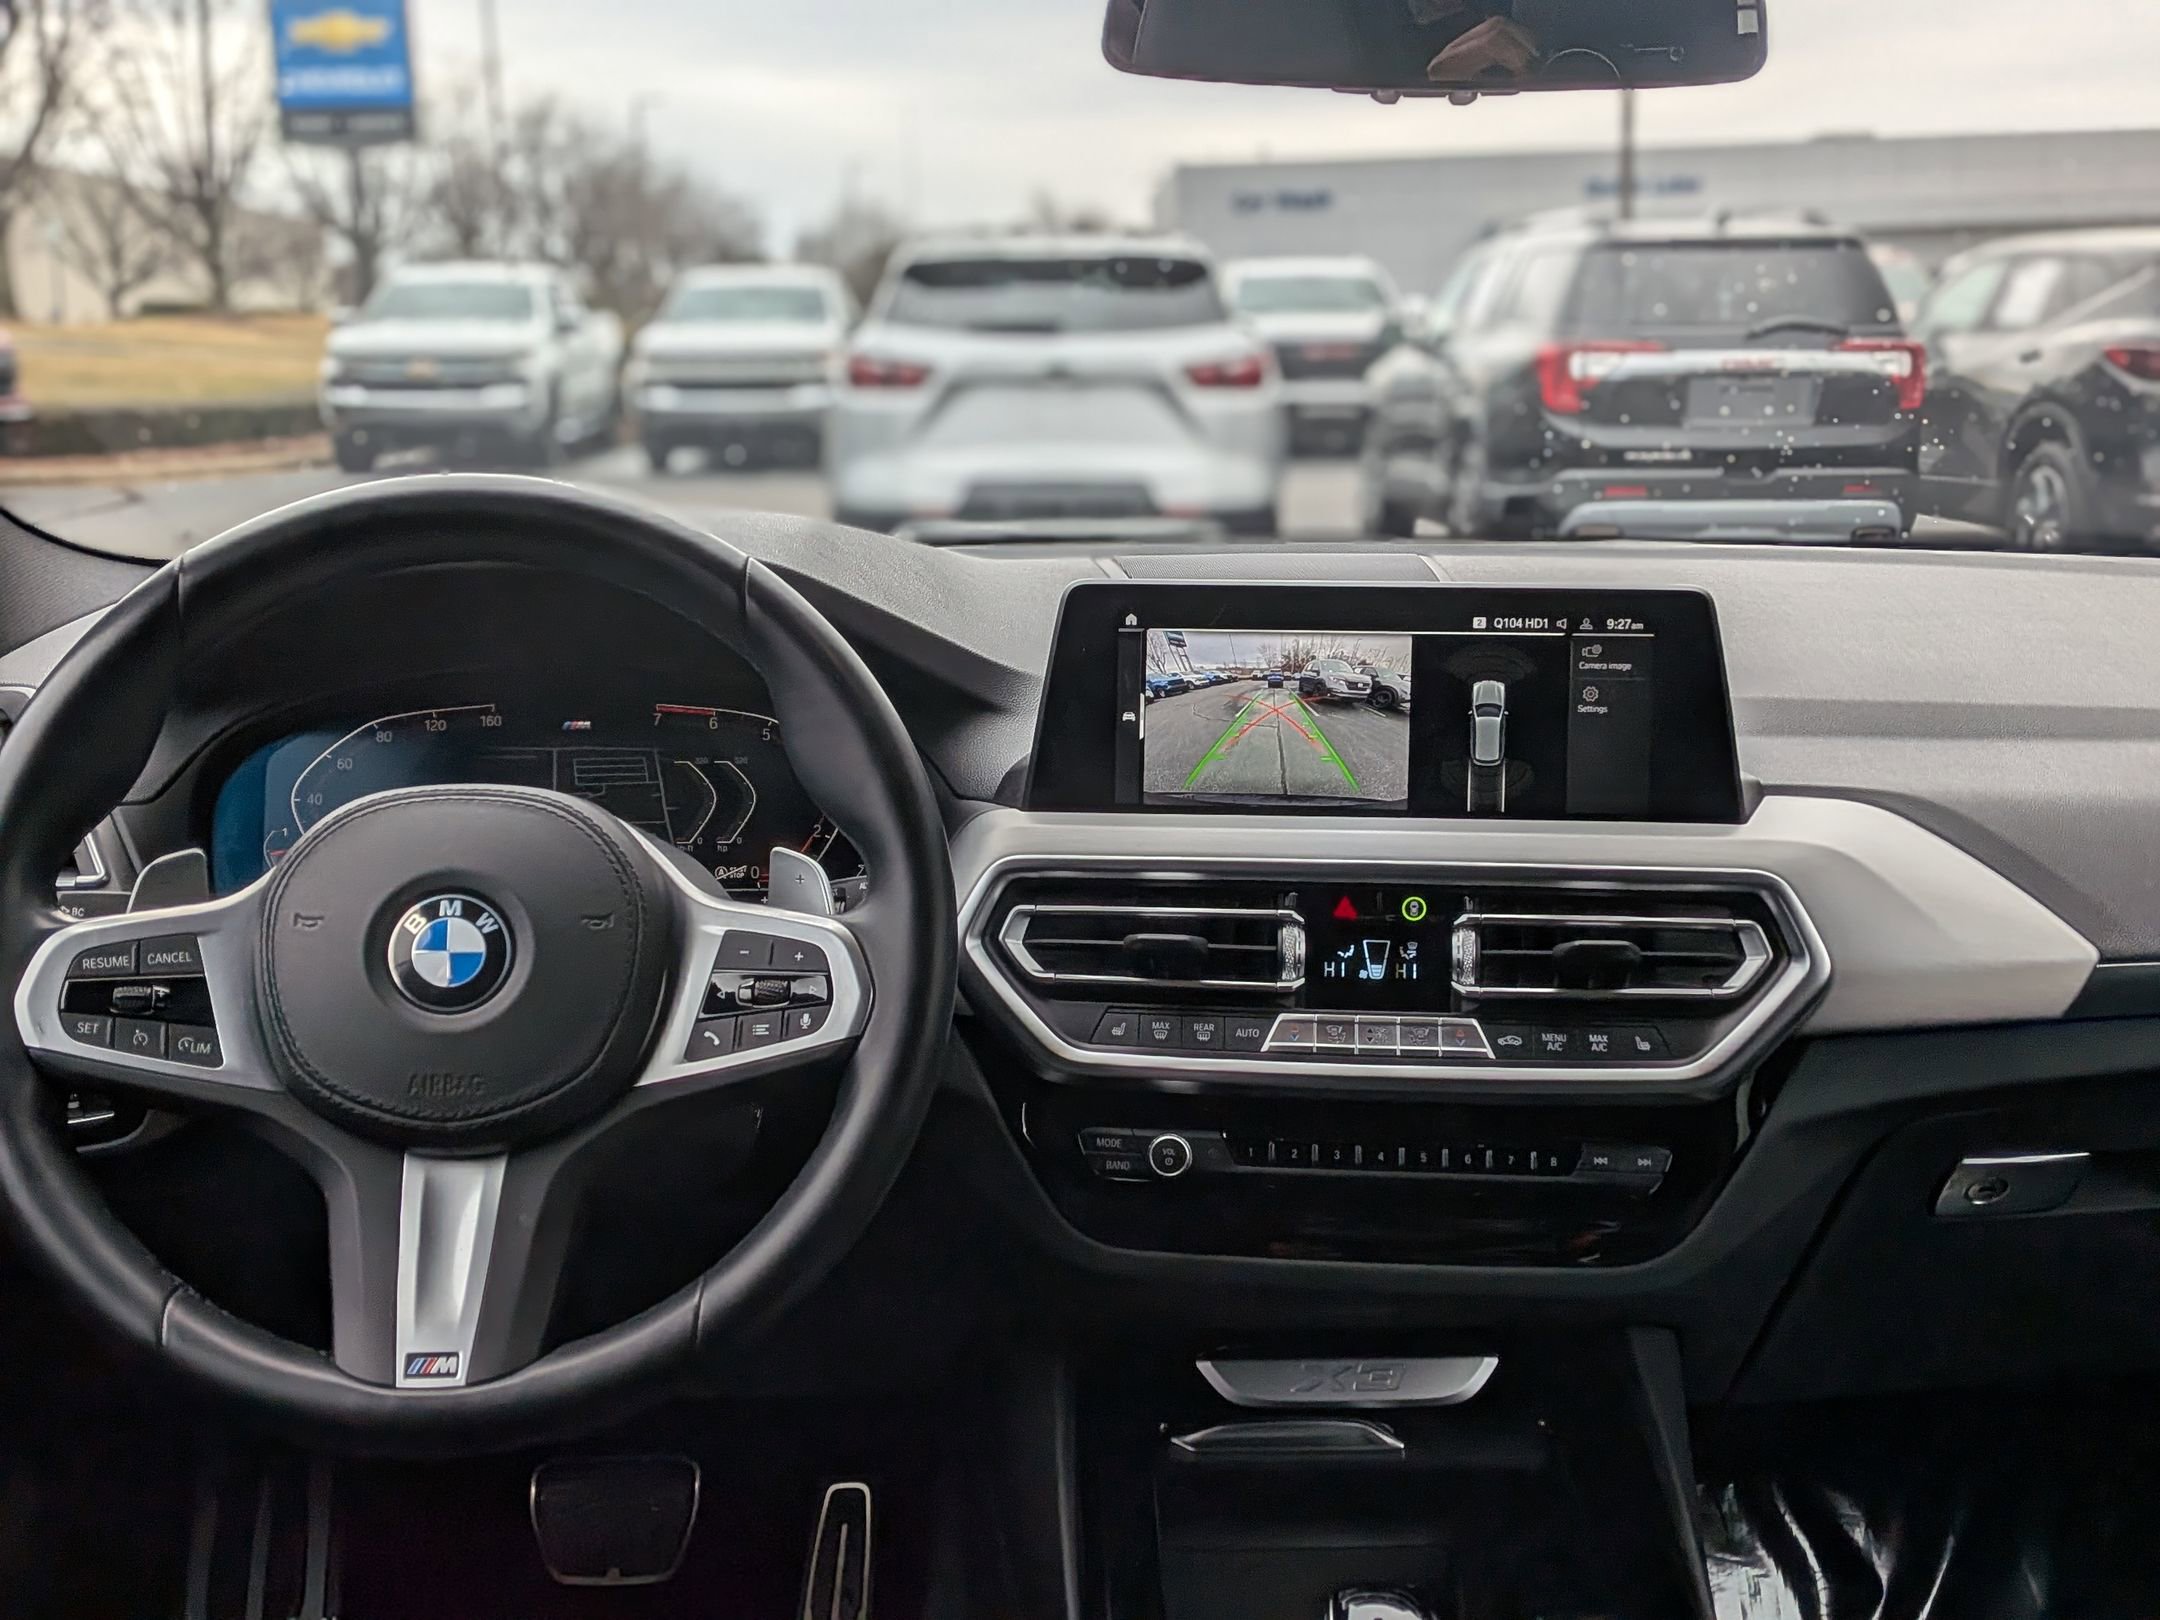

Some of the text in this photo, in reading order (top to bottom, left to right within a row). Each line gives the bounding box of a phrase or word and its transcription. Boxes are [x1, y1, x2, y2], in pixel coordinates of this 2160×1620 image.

[1494, 617, 1549, 629] Q104 HD1
[1579, 661, 1632, 671] Camera image
[1577, 704, 1608, 714] Settings
[424, 719, 447, 731] 120
[480, 715, 502, 727] 160
[653, 712, 662, 726] 7
[709, 716, 718, 730] 6
[376, 730, 392, 743] 80
[762, 728, 770, 741] 5
[337, 758, 353, 770] 60
[307, 794, 322, 806] 40
[813, 824, 822, 838] 2
[750, 865, 760, 879] 0
[403, 899, 500, 935] BMW
[82, 955, 130, 970] RESUME
[147, 951, 193, 965] CANCEL
[1324, 961, 1345, 978] HI
[1395, 963, 1417, 980] HI
[77, 1021, 100, 1035] SET
[1152, 1021, 1170, 1030] MAX
[1193, 1023, 1215, 1031] REAR
[1235, 1028, 1260, 1038] AUTO
[1541, 1033, 1567, 1043] MENU
[1588, 1034, 1609, 1043] MAX
[190, 1042, 212, 1056] LIM
[1096, 1137, 1122, 1149] MODE
[1291, 1148, 1298, 1159] 2
[1333, 1150, 1341, 1160] 3
[1377, 1151, 1385, 1162] 4
[1464, 1154, 1472, 1165] 6
[1105, 1159, 1131, 1170] BAND
[1550, 1156, 1557, 1167] 8
